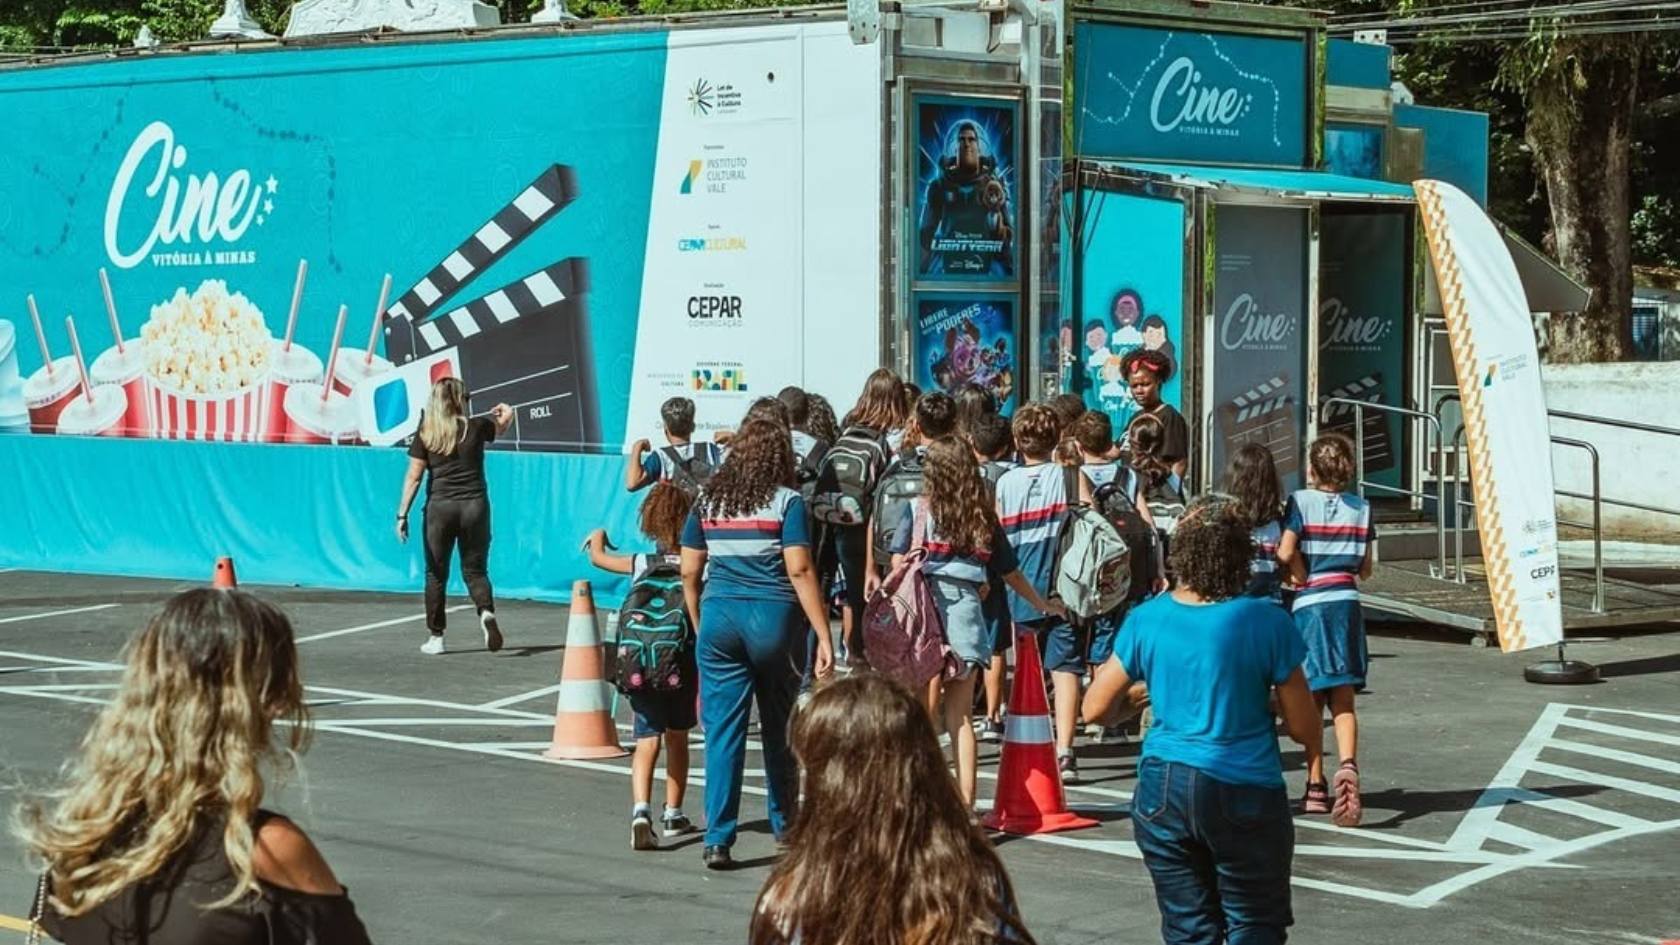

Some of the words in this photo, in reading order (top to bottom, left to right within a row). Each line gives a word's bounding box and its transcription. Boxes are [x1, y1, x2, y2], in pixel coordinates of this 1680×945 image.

[1150, 56, 1244, 132] Cine
[707, 157, 747, 168] INSTITUTO
[707, 170, 747, 181] CULTURAL
[104, 121, 262, 268] Cine
[707, 183, 726, 193] VALE
[152, 251, 201, 267] VITÓRIA
[204, 249, 213, 265] À
[215, 251, 256, 265] MINAS
[687, 296, 742, 319] CEPAR
[935, 303, 981, 334] PODERES
[1221, 293, 1290, 350] Cine
[530, 405, 552, 419] ROLL
